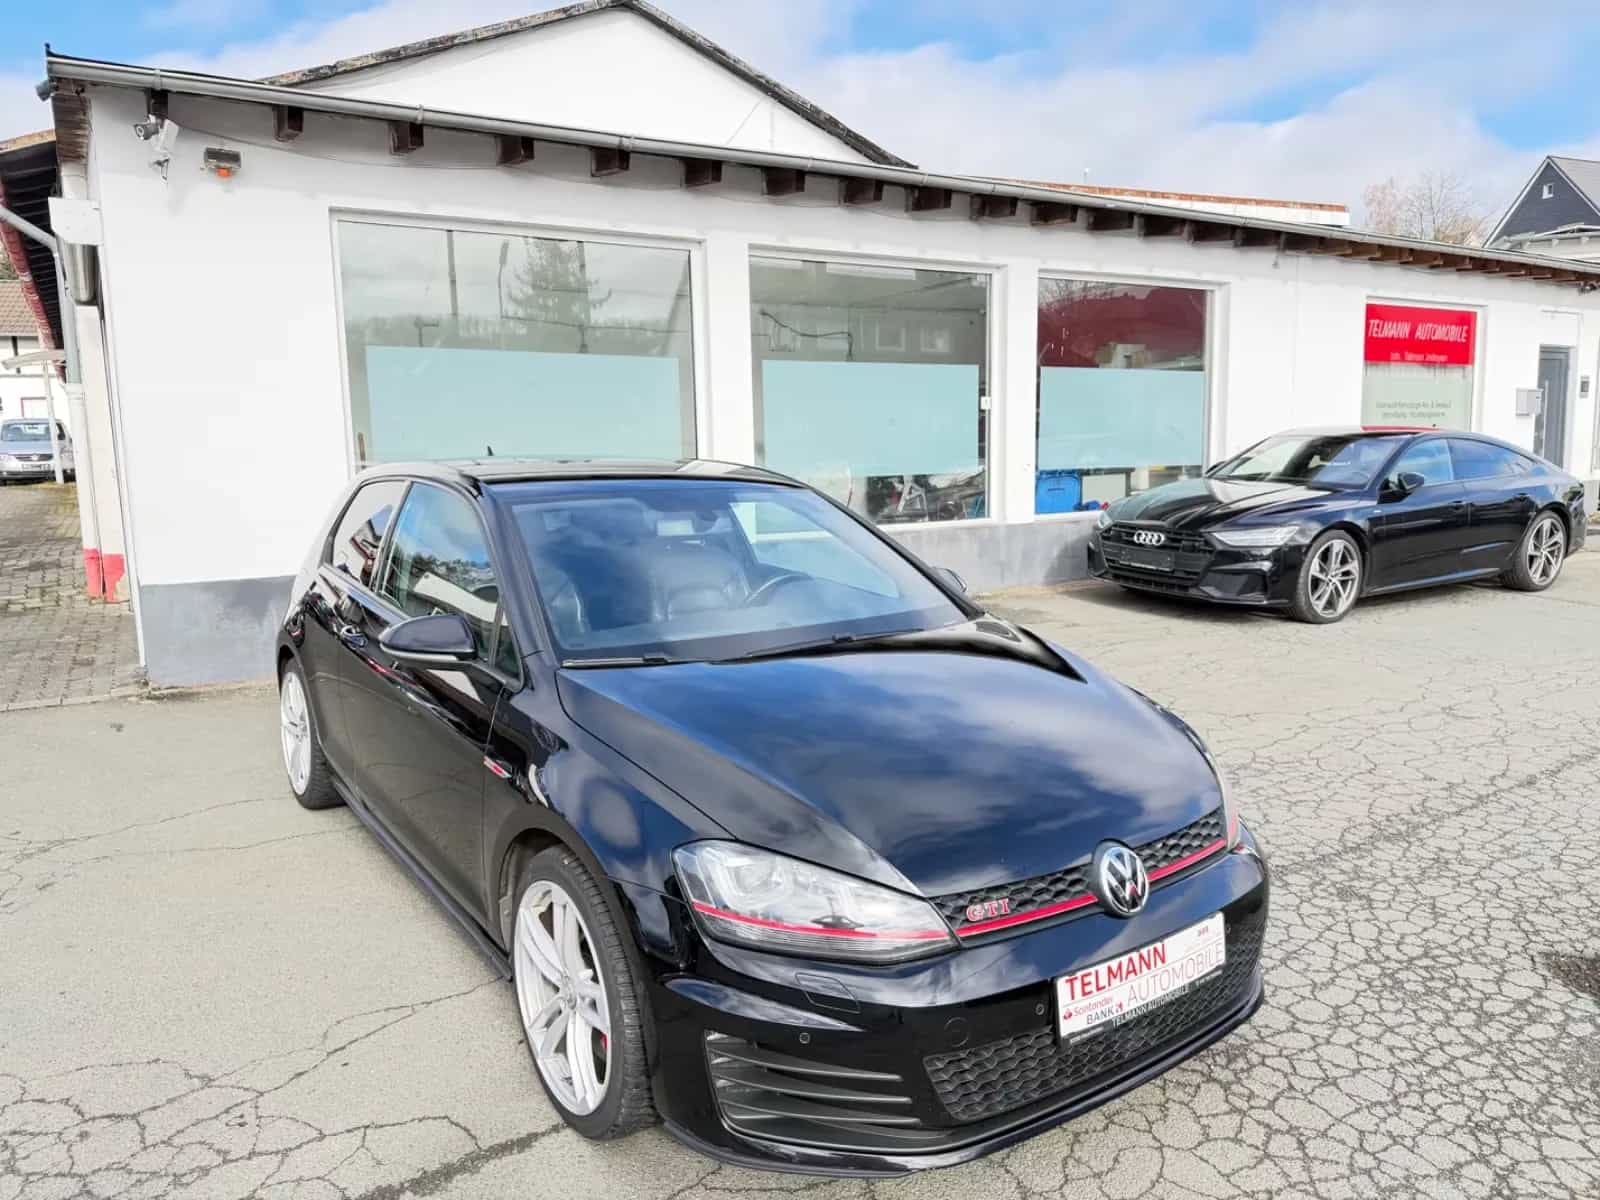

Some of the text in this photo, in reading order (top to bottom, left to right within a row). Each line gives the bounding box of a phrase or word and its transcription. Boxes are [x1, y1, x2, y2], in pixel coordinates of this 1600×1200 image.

[1368, 319, 1467, 342] TELMANN AUTOMOBILE
[967, 898, 1010, 922] GTI
[1065, 943, 1166, 1000] TELMANN
[1127, 942, 1223, 1006] AUTOMOBILE
[1087, 1005, 1114, 1024] BANK
